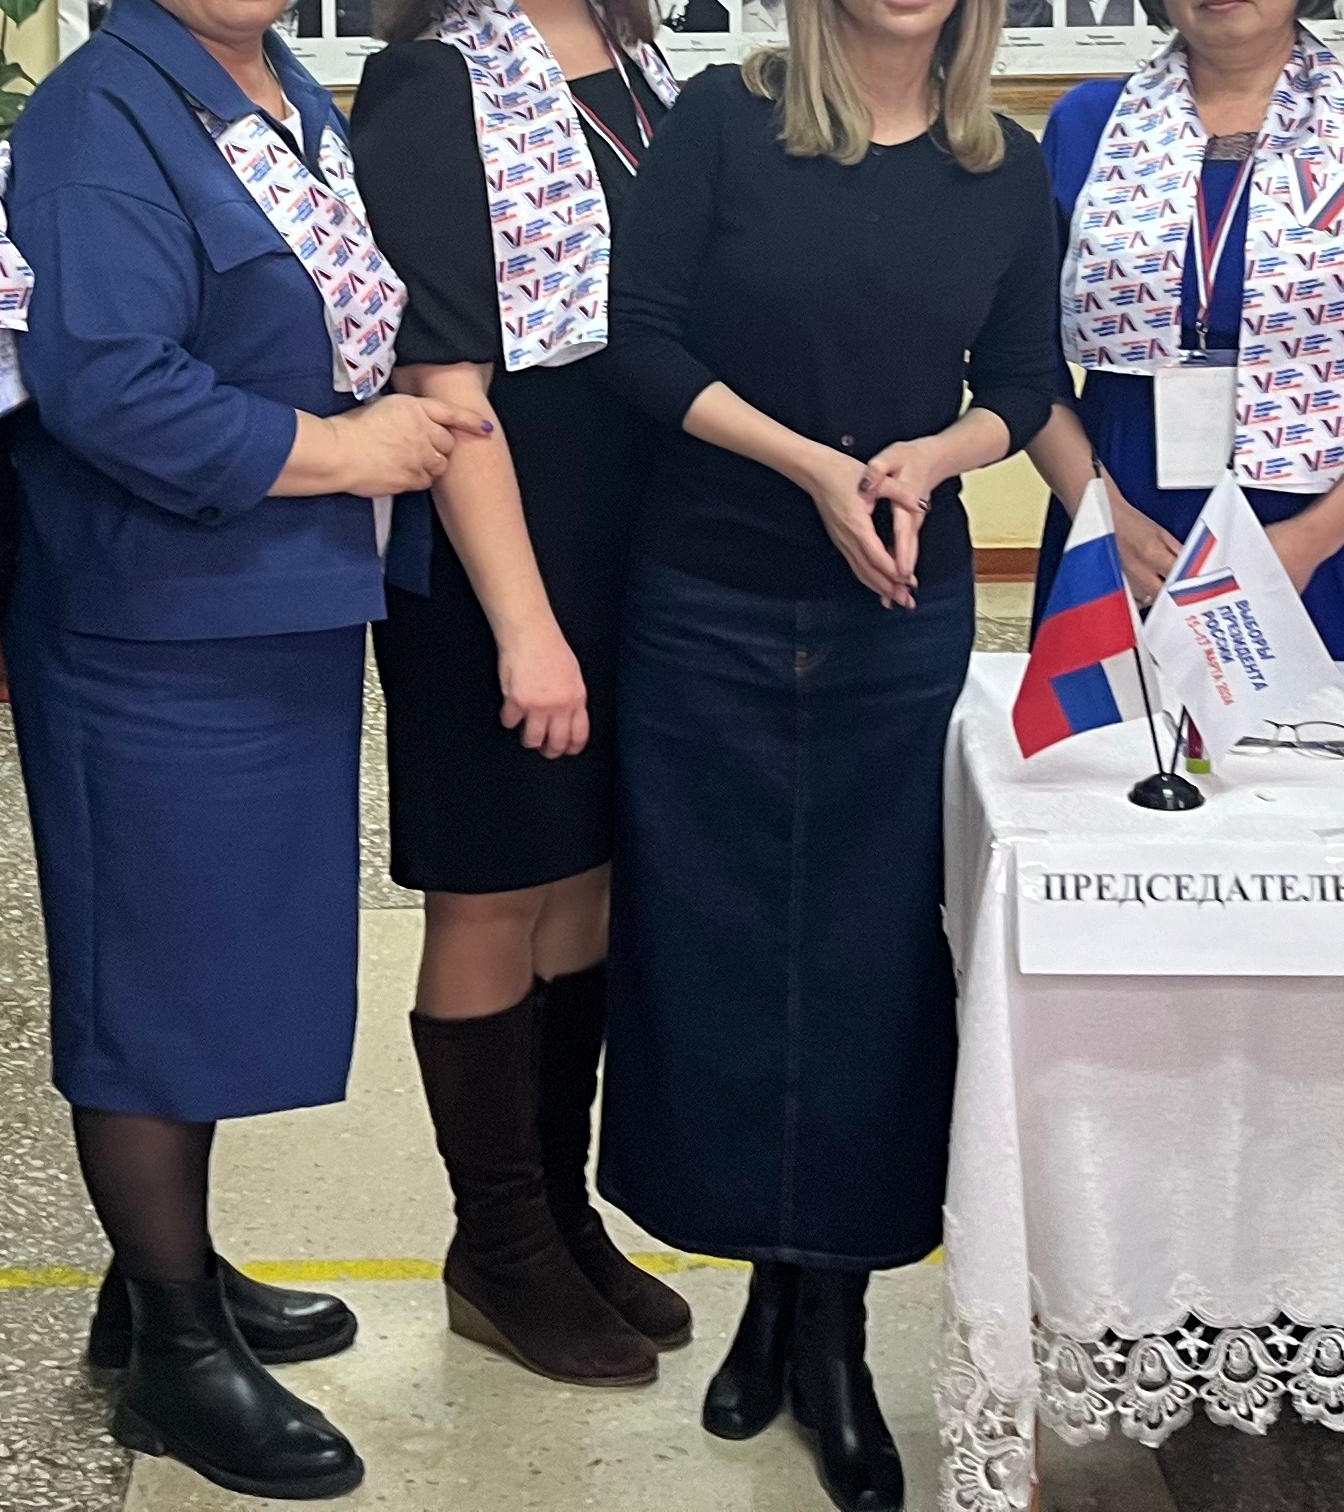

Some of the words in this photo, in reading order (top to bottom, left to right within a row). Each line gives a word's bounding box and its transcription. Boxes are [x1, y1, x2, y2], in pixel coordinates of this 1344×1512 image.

[1201, 611, 1235, 663] РОССИИ
[1217, 606, 1268, 690] ПРЕЗИДЕНТА
[1235, 600, 1275, 659] ВЫБОРЫ
